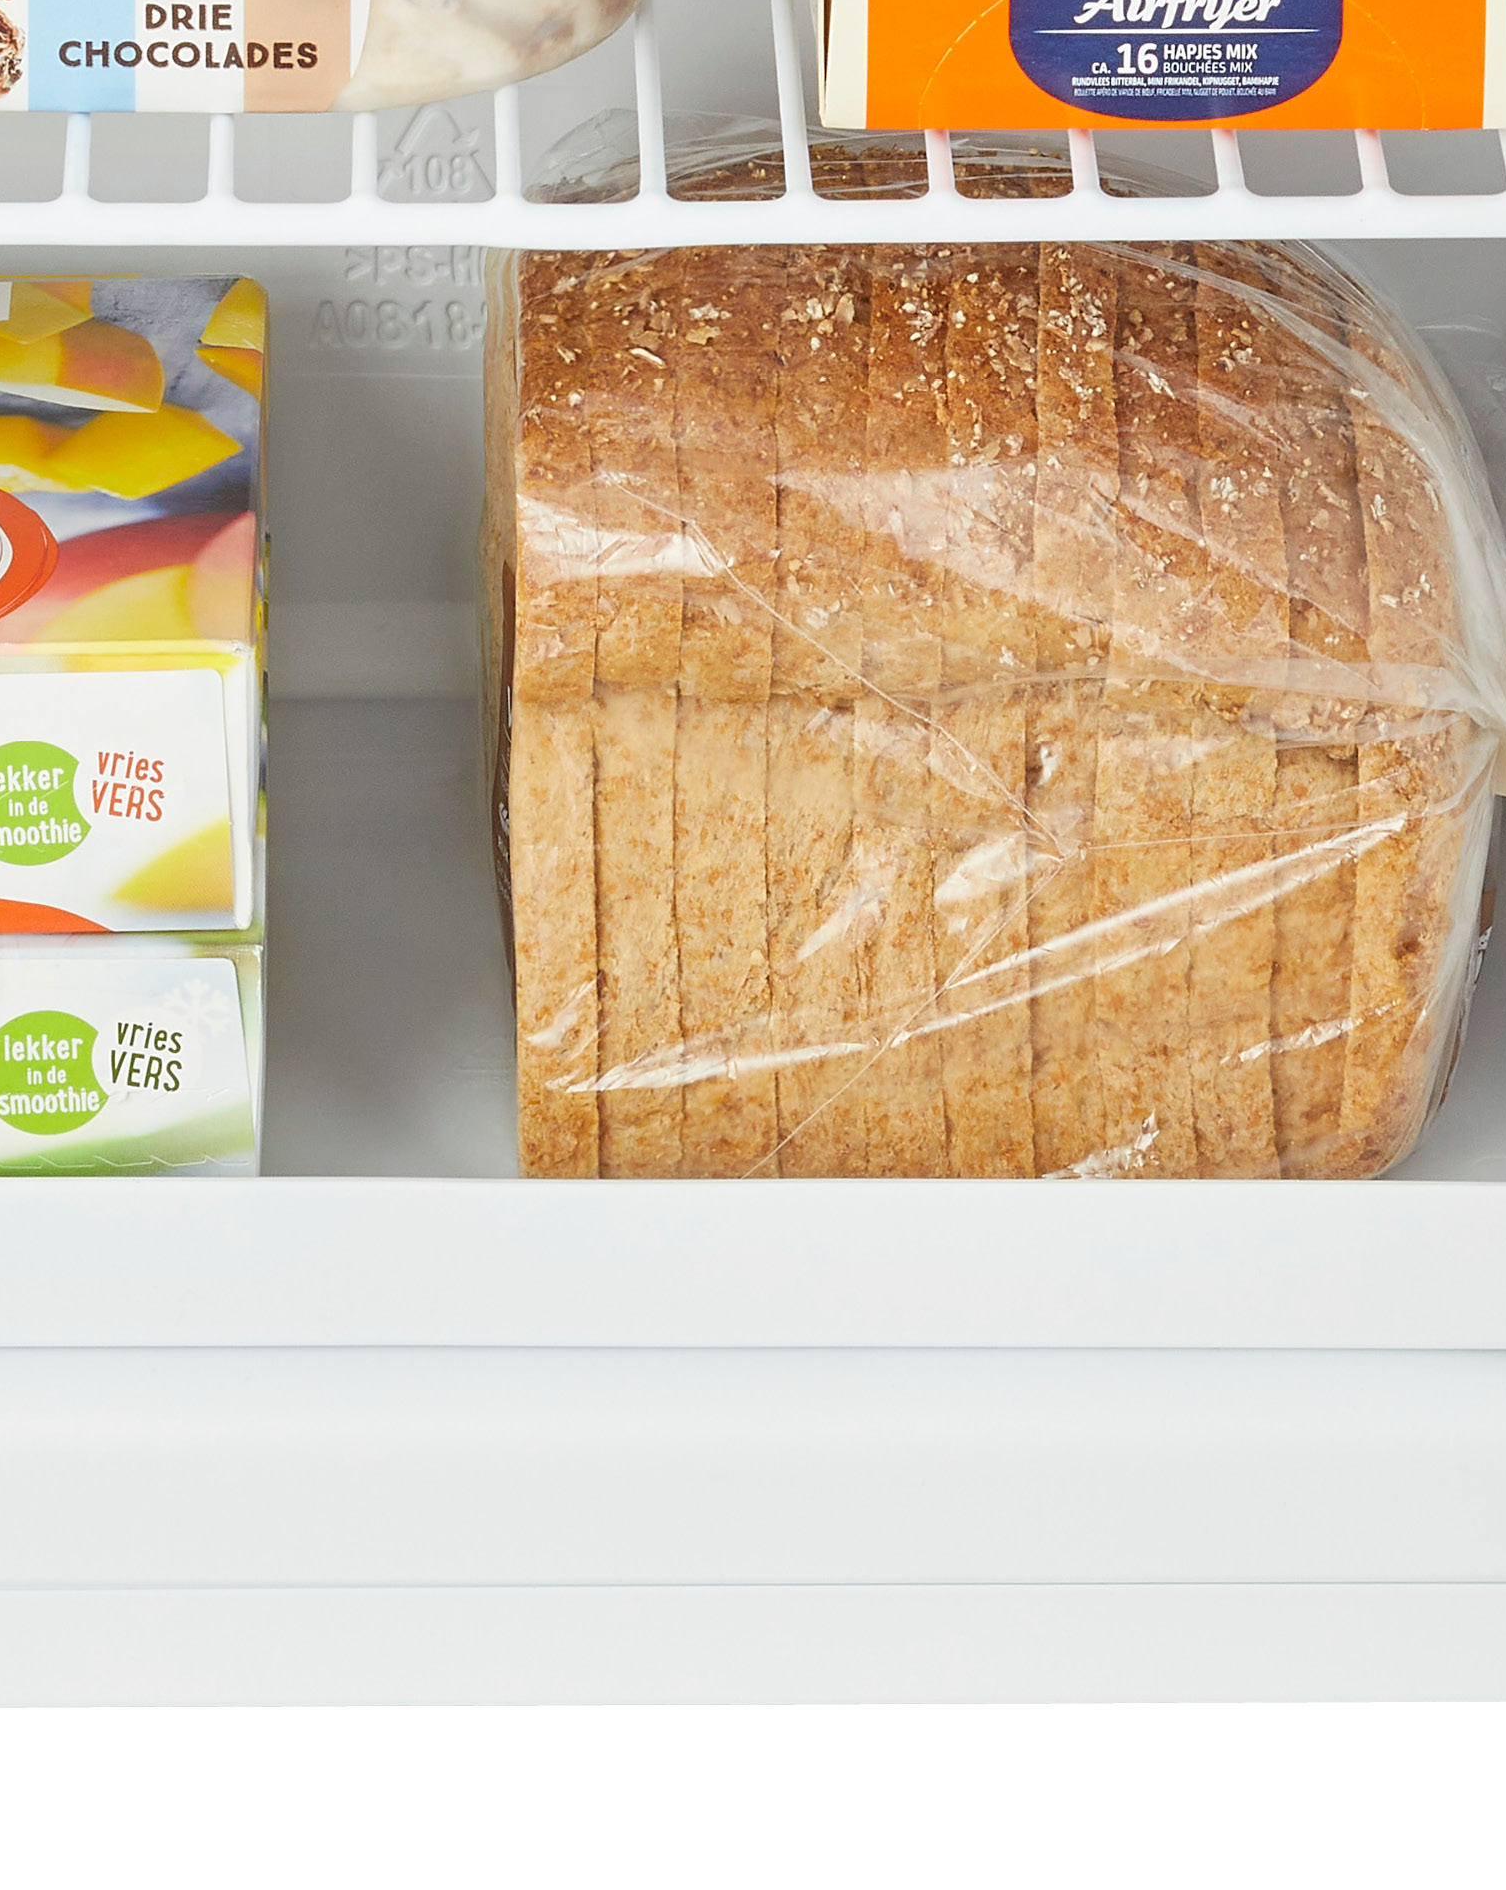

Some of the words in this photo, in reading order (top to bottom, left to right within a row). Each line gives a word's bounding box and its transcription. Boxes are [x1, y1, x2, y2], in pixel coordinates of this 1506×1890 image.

[144, 3, 233, 31] DRIE
[58, 41, 319, 69] CHOCOLADES
[1091, 61, 1112, 75] CA.
[1117, 42, 1159, 75] 16
[1163, 43, 1223, 61] HAPJES
[1226, 43, 1259, 61] MIX
[1163, 59, 1227, 74] BOUCHÉES
[1229, 61, 1254, 74] MIX
[402, 153, 476, 195] 108
[98, 750, 165, 783] vries
[7, 798, 25, 818] in
[28, 795, 50, 816] de
[91, 779, 165, 822] VERS
[3, 1034, 85, 1062] lekker
[116, 1021, 183, 1055] vries
[26, 1066, 43, 1086] in
[46, 1064, 67, 1084] de
[110, 1049, 183, 1093] VERS
